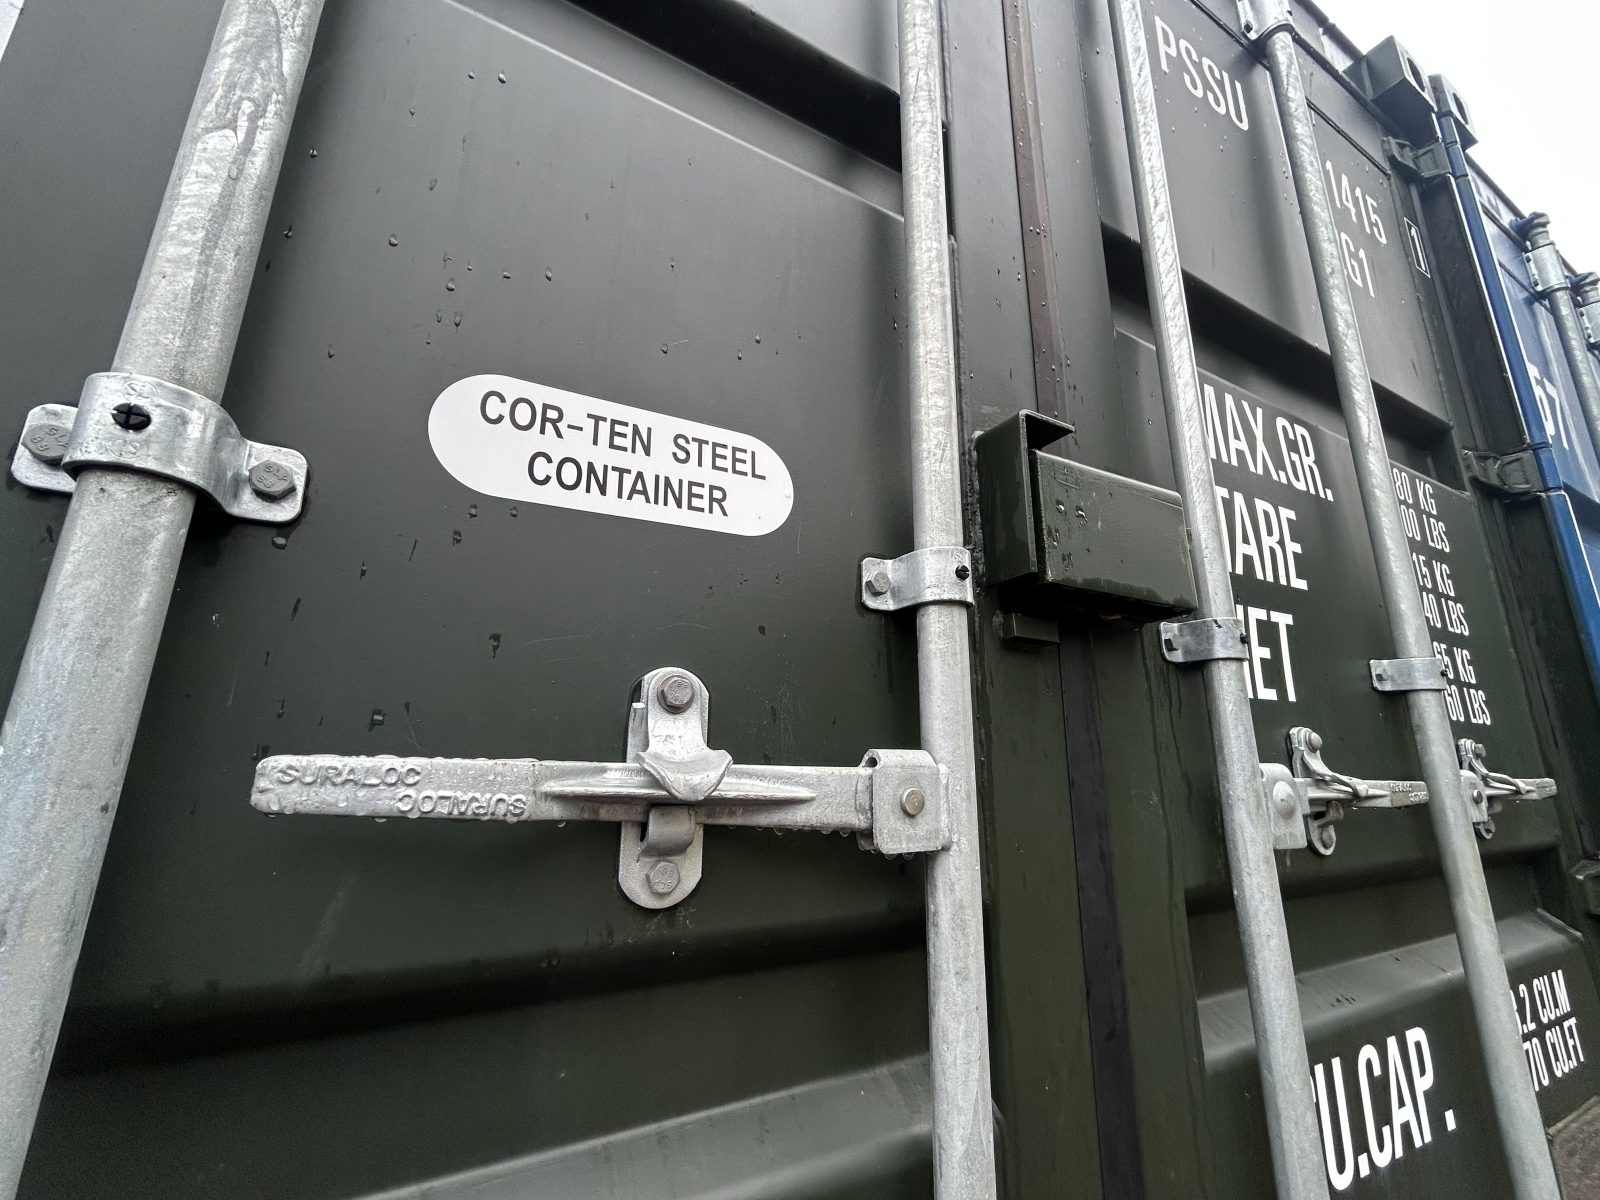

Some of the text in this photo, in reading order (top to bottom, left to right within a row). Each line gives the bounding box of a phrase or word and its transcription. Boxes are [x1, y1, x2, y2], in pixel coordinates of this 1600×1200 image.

[1154, 14, 1249, 131] PSSU
[1325, 159, 1388, 244] 1415
[1340, 231, 1376, 298] G1
[480, 390, 767, 481] COR-TEN STEEL
[1203, 383, 1438, 515] MAX.GR. 80 KG
[527, 450, 729, 517] CONTAINER
[1400, 504, 1451, 553] 00 LBS
[1412, 552, 1432, 589] 15
[1432, 560, 1456, 597] KG
[1422, 591, 1470, 636] 40 LBS
[1453, 646, 1477, 684] KG
[1443, 683, 1492, 726] 60 LBS
[275, 763, 422, 788] SURALOC
[396, 790, 528, 818] SURALOC
[1509, 968, 1571, 1035] .2 CU.M
[1309, 1026, 1457, 1191] U.CAP.
[1544, 1016, 1585, 1078] CU.FT
